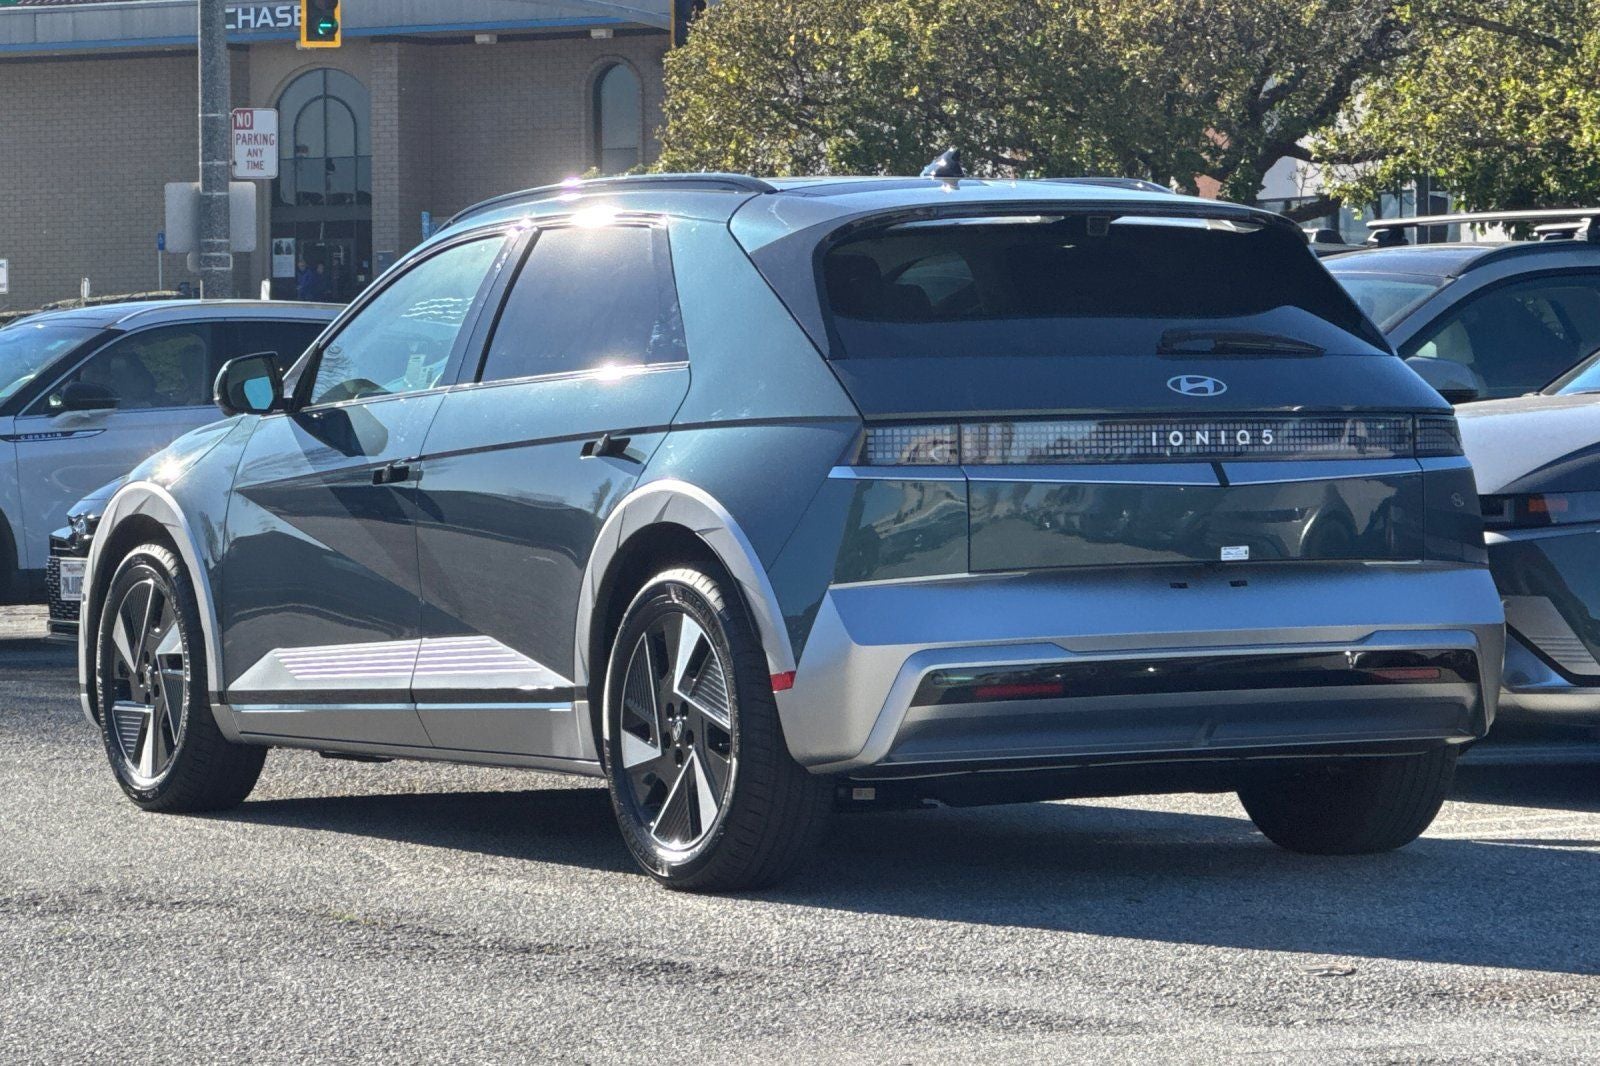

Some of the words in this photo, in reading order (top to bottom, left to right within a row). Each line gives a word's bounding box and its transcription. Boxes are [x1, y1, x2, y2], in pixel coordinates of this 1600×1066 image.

[236, 112, 251, 128] NO
[235, 132, 275, 146] PARKING
[246, 148, 264, 158] ANY
[246, 160, 264, 170] TIME
